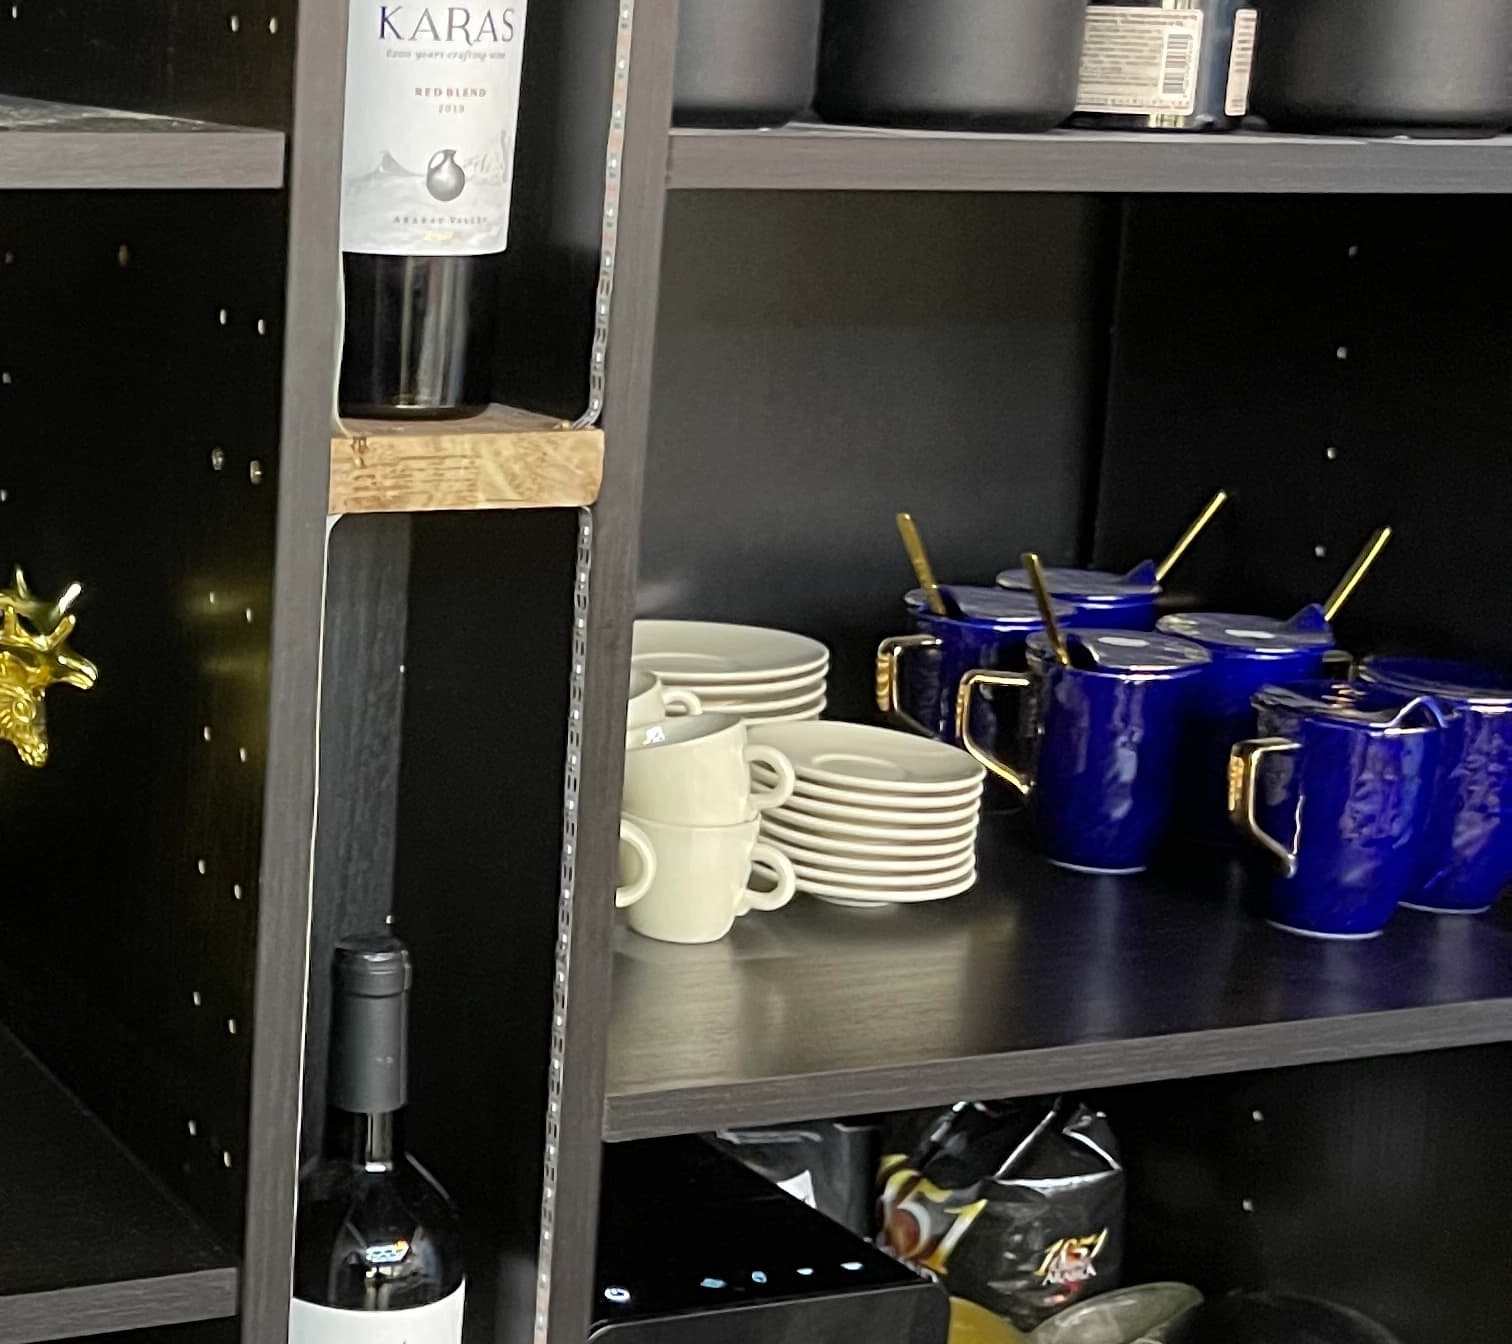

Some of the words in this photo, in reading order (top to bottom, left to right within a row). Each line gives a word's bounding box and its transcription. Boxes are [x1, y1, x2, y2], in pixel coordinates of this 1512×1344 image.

[379, 5, 515, 46] KARAS
[415, 87, 443, 97] RED
[446, 87, 487, 98] BLEND
